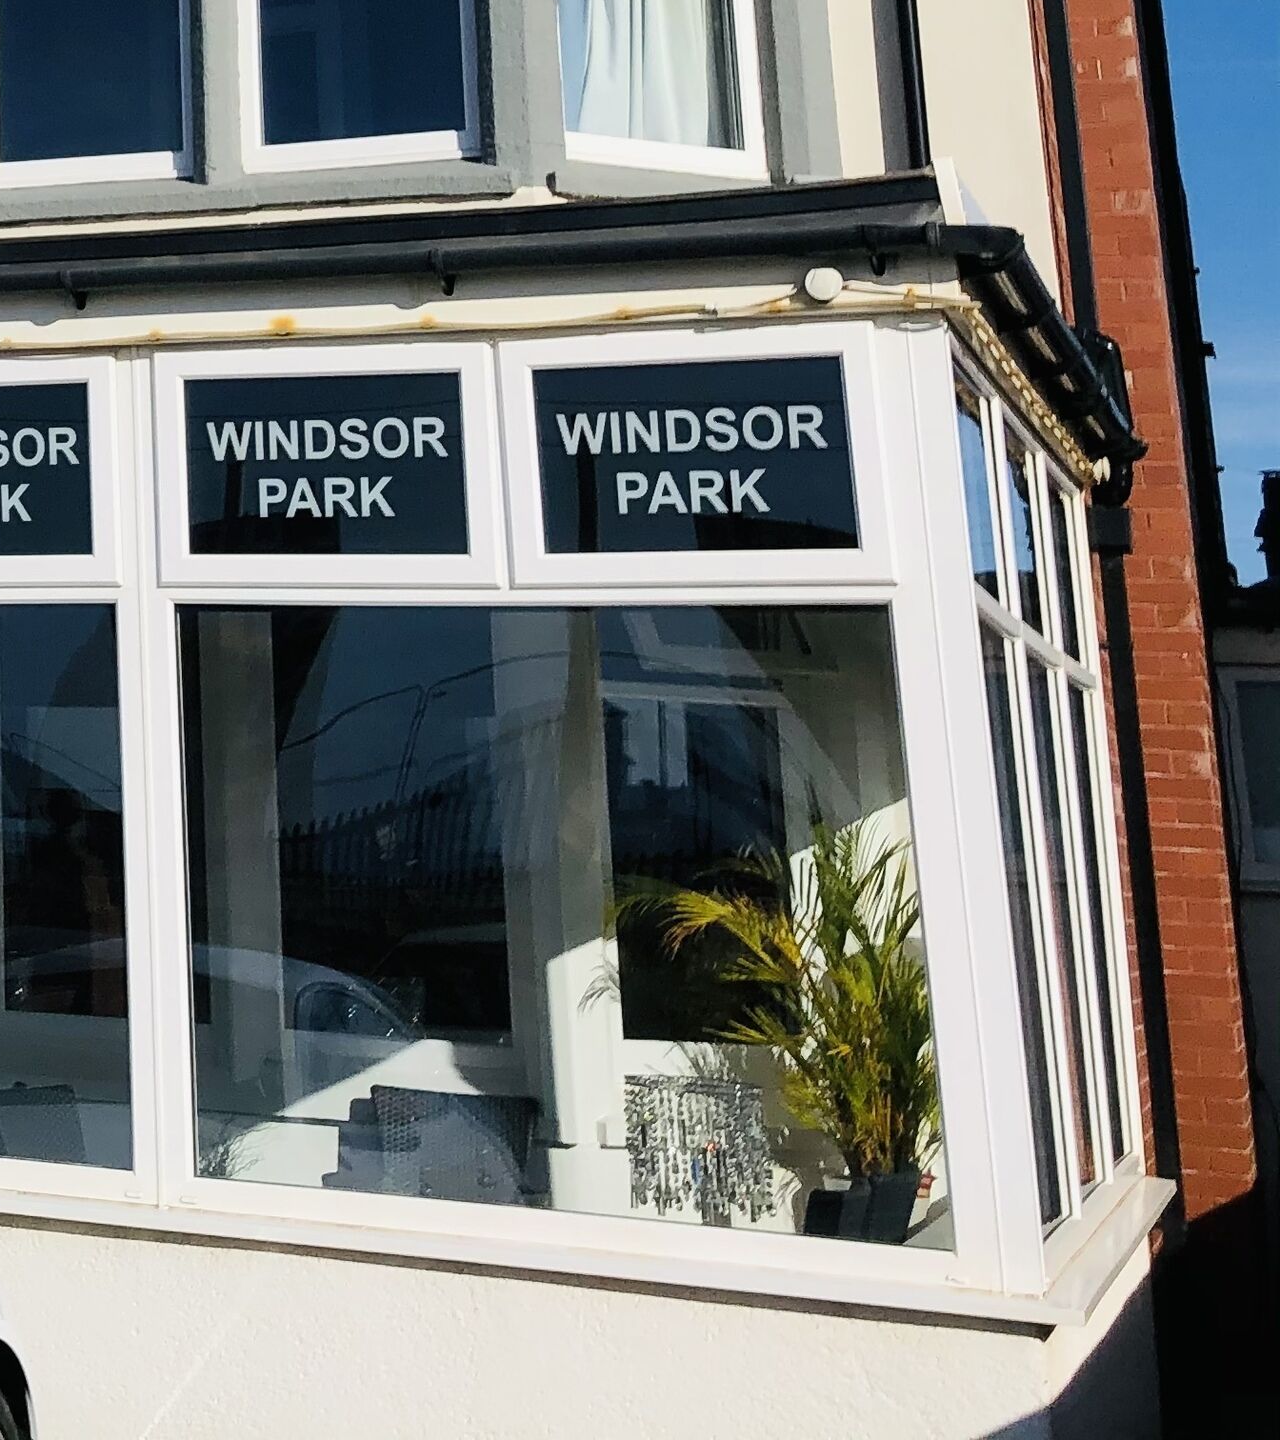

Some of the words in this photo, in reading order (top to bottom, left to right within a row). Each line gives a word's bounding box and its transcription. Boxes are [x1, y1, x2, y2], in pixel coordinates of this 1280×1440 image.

[207, 417, 448, 461] WINDSOR
[557, 406, 827, 454] WINDSOR
[259, 477, 395, 517] PARK
[617, 469, 770, 513] PARK
